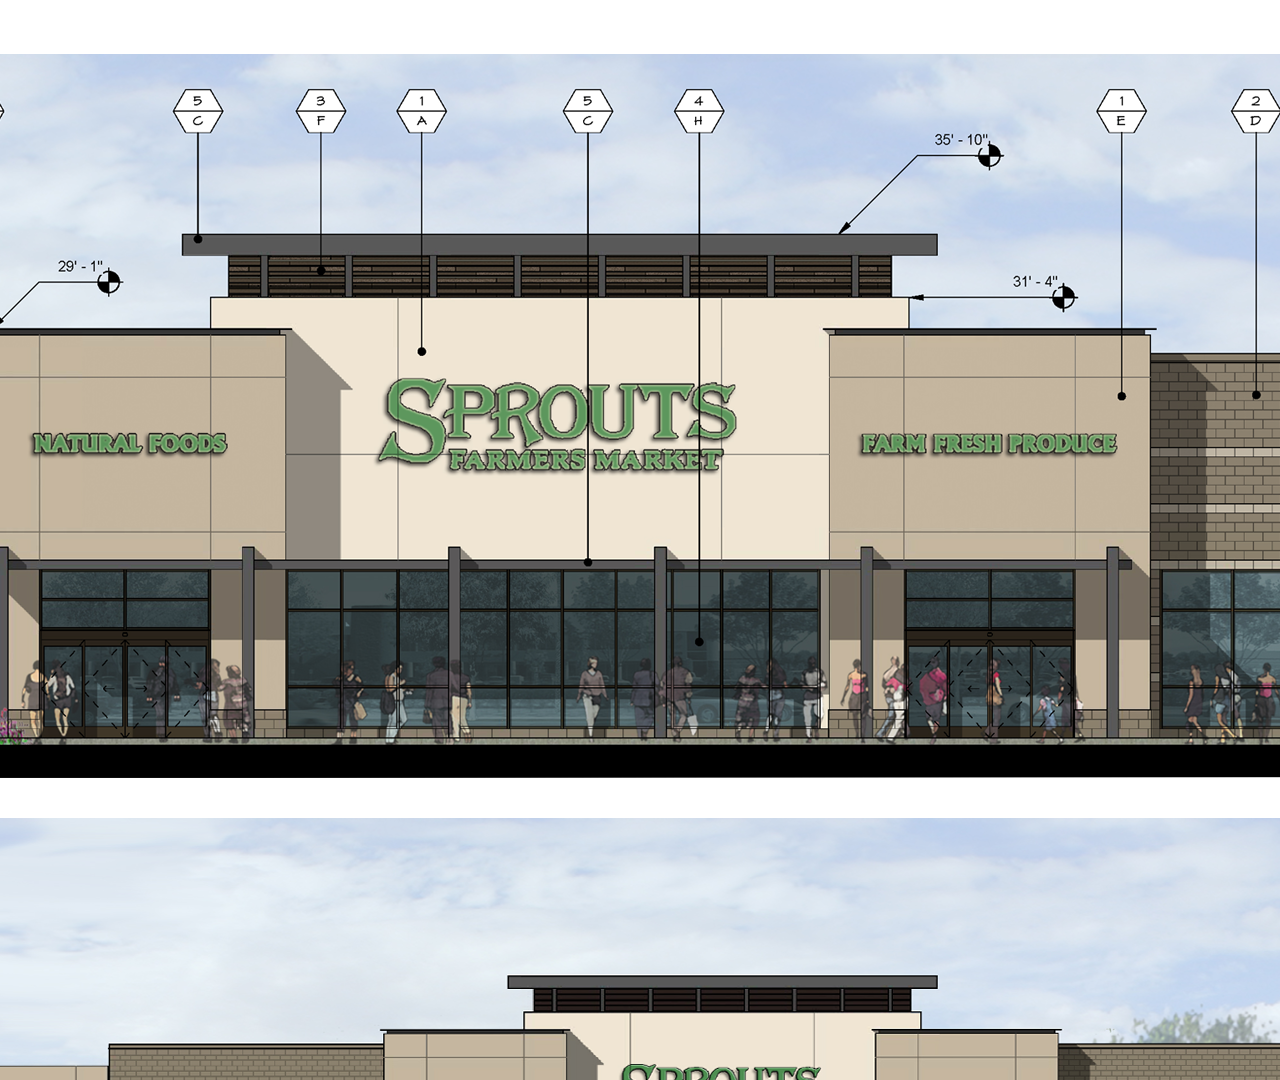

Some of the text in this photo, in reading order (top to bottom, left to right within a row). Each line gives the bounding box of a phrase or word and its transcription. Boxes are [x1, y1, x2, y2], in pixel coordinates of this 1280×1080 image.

[193, 95, 203, 107] 5
[316, 95, 326, 107] 3
[583, 95, 593, 107] 5
[694, 95, 704, 106] 4
[1251, 95, 1261, 107] 2
[192, 115, 204, 126] C
[317, 115, 326, 126] F
[416, 115, 428, 126] A
[582, 115, 594, 126] C
[694, 115, 703, 126] H
[1116, 115, 1126, 126] E
[1250, 115, 1262, 126] D
[934, 133, 954, 146] 35'
[58, 260, 77, 273] 29'
[1013, 275, 1032, 288] 31'
[378, 377, 737, 465] SPROUTS
[33, 433, 228, 453] NATURAL FOODS
[862, 434, 1118, 453] FARM FRESH PRODUCE
[448, 448, 724, 471] FARMERS MARKET
